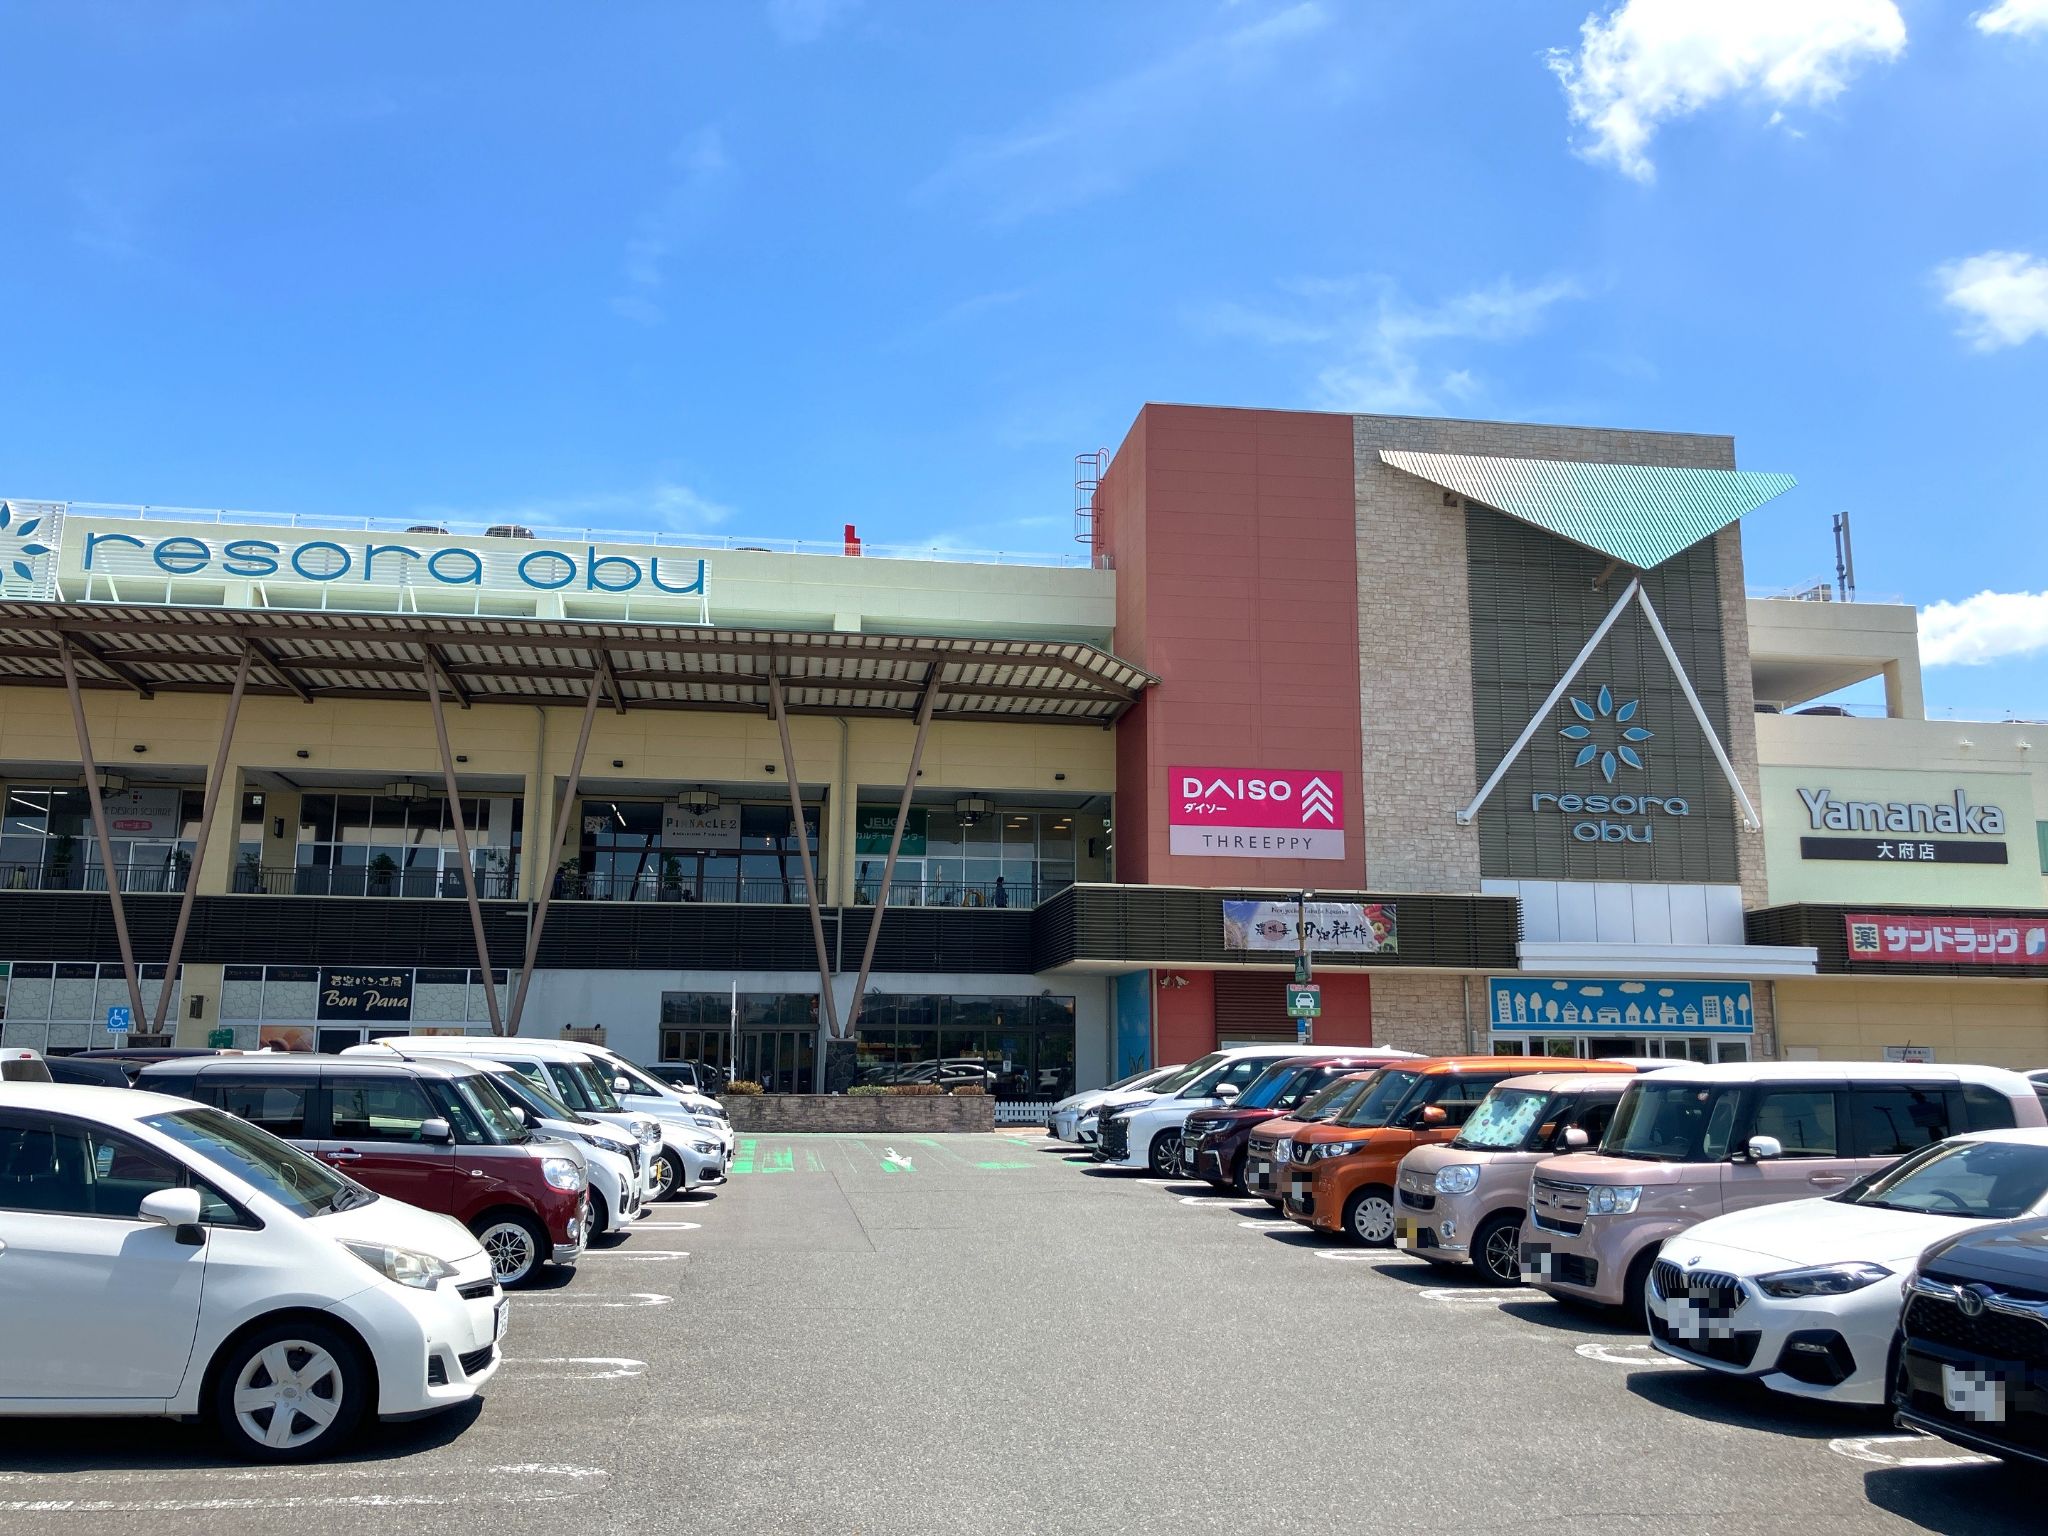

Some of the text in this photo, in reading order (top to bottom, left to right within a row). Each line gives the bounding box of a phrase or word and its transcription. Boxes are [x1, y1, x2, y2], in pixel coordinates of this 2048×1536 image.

[84, 532, 704, 594] resora obu
[1183, 777, 1291, 801] DAISO
[1183, 803, 1227, 814] ダイソー
[1532, 793, 1689, 816] resora
[1797, 789, 2005, 834] Yamanaka
[1202, 833, 1313, 850] THREEPPY
[1573, 820, 1652, 843] obu
[1876, 841, 1936, 860] 大府店
[1853, 925, 2019, 954] 薬 サンドラッグ
[322, 989, 409, 1012] Bon Pana
